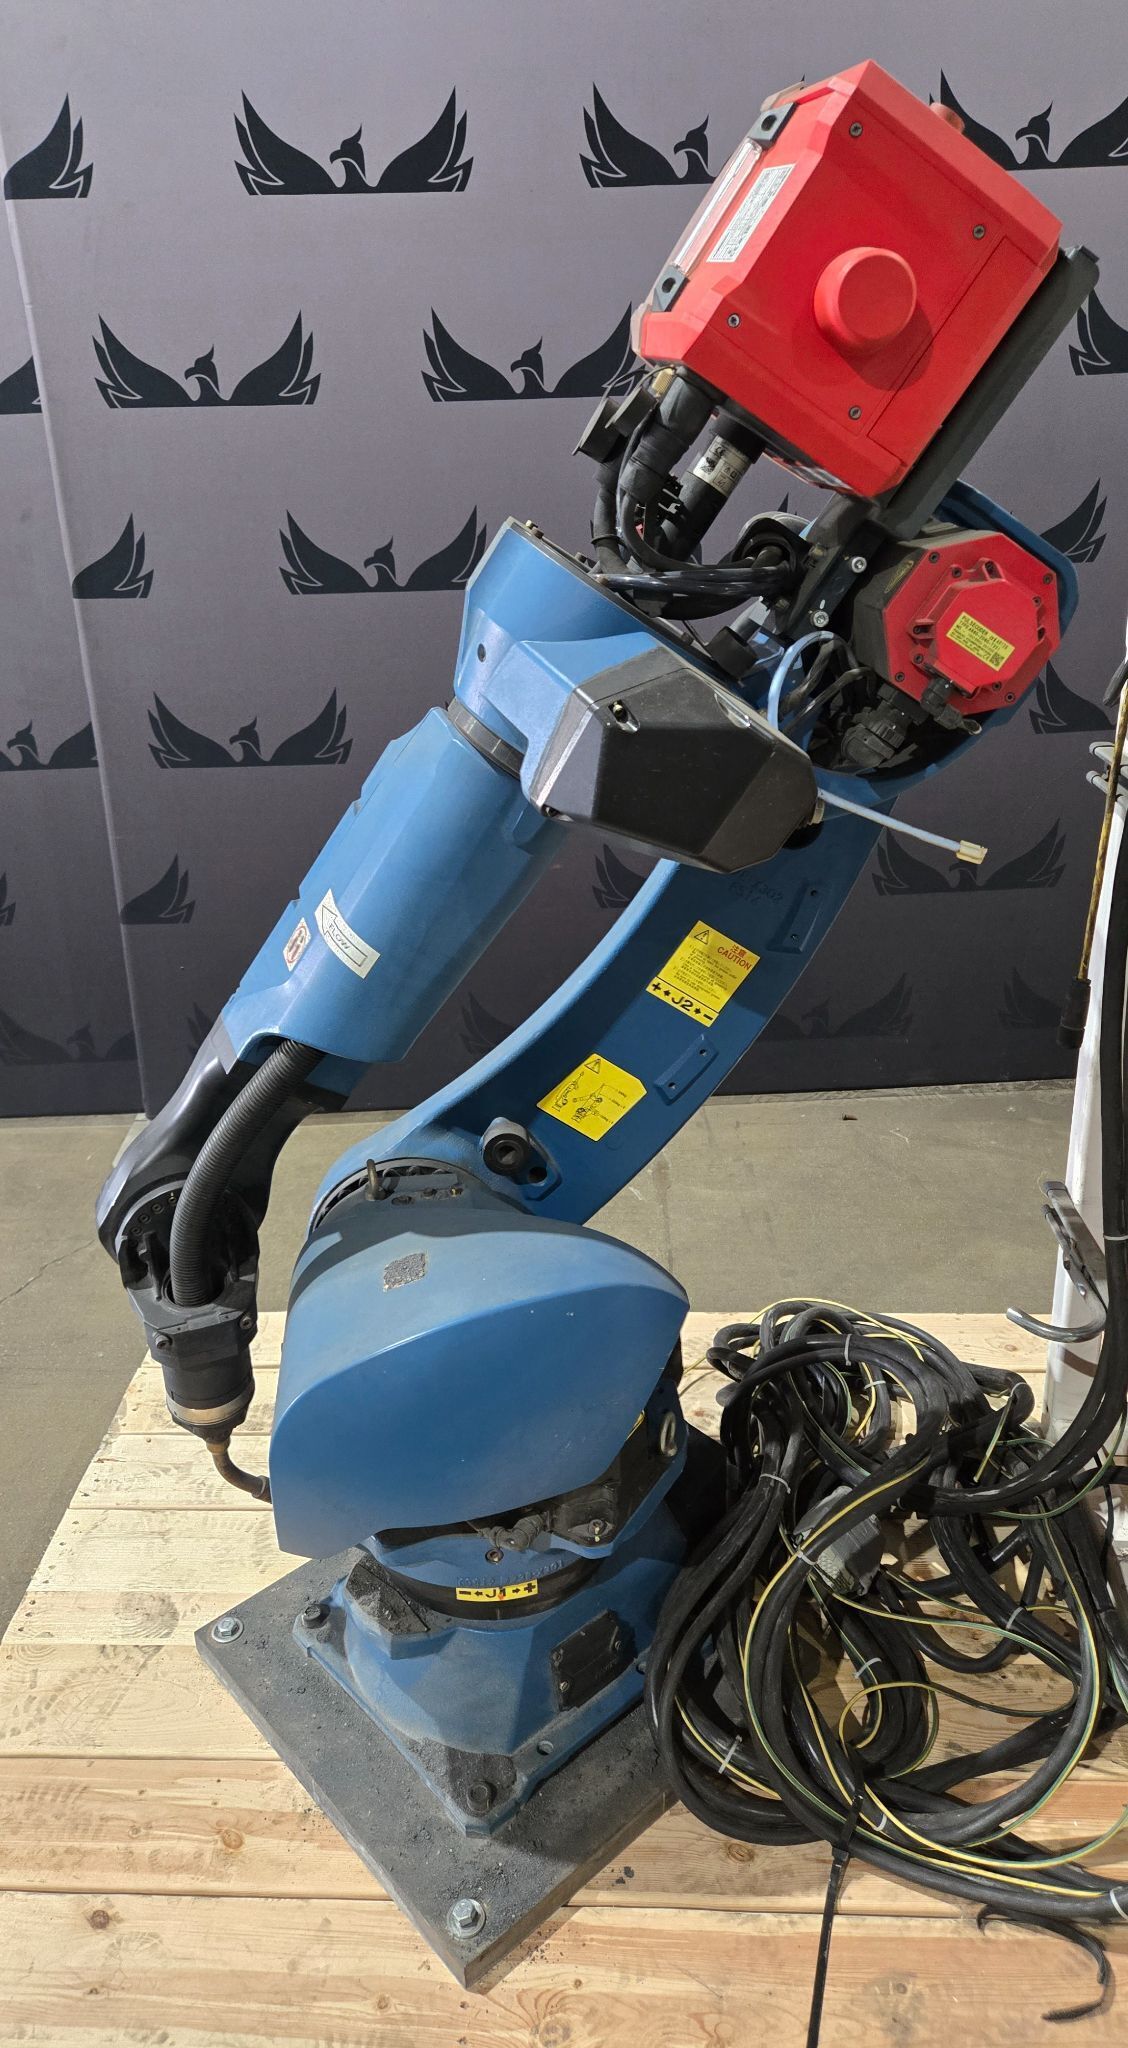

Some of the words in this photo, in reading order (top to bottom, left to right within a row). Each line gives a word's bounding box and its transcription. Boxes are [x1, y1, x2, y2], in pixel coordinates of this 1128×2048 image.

[328, 923, 351, 949] FLOW
[717, 946, 752, 971] CAUTION
[671, 996, 694, 1012] J2
[485, 1588, 506, 1598] J1
